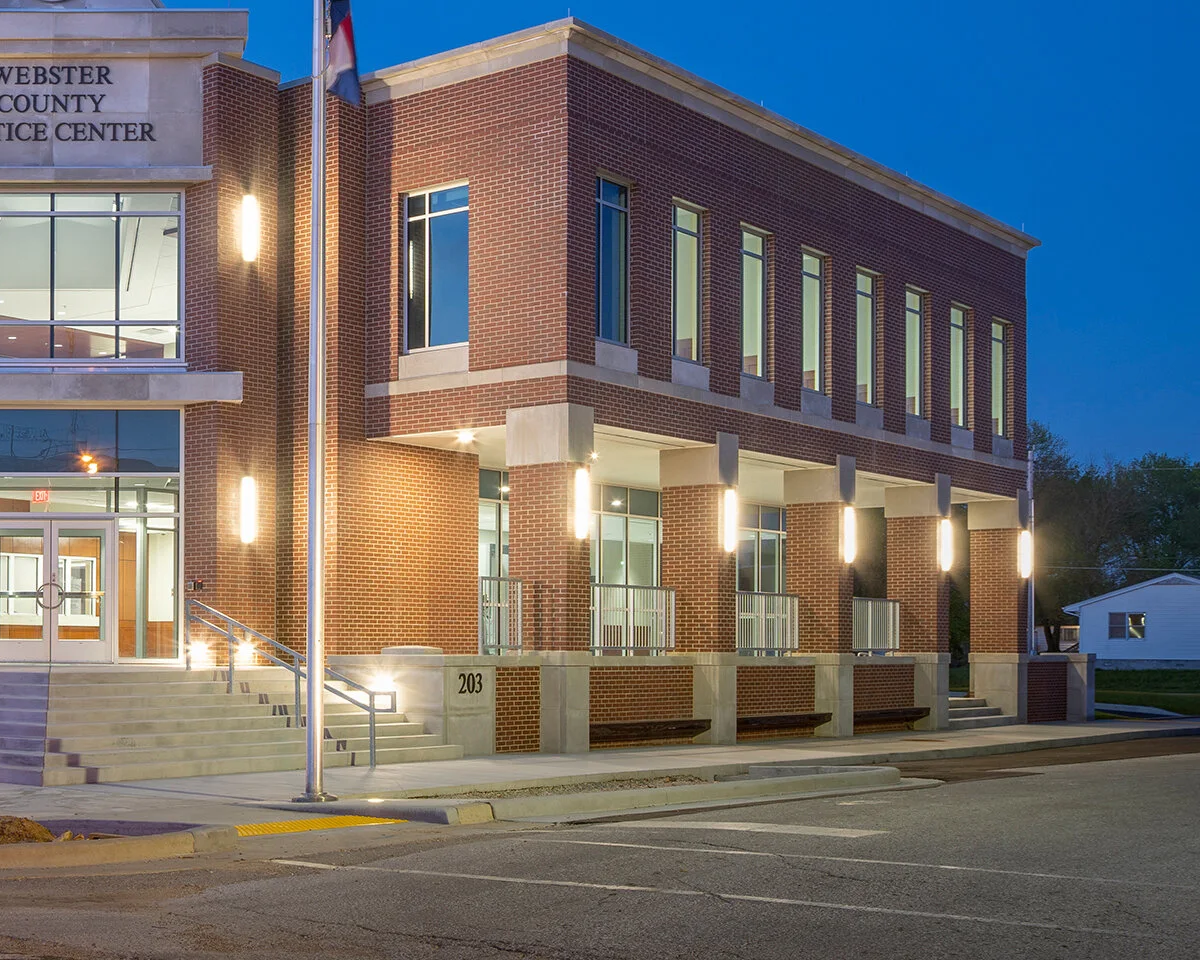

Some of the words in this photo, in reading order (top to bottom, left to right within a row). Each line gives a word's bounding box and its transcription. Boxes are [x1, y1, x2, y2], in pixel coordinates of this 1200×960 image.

[54, 122, 156, 142] CENTER
[35, 490, 47, 501] EXIT
[458, 673, 483, 694] 203
